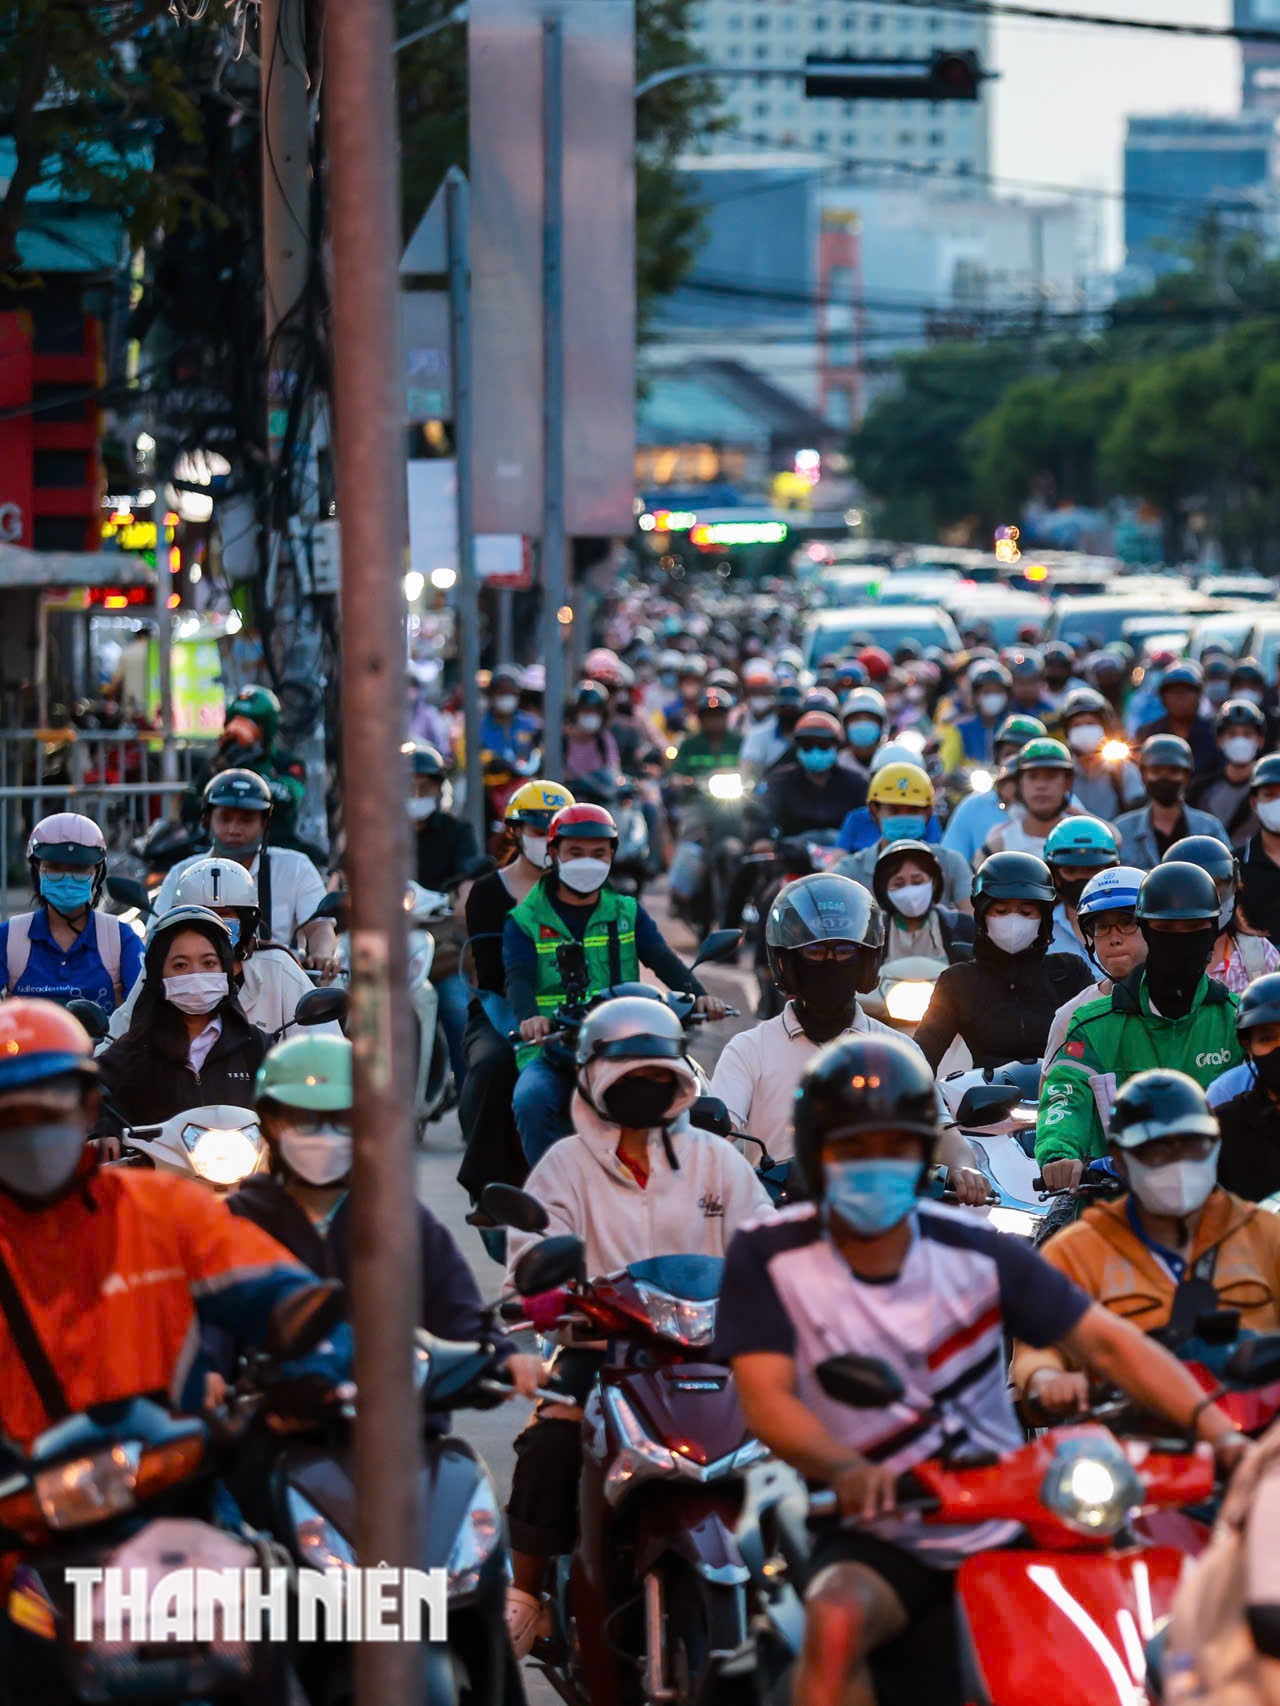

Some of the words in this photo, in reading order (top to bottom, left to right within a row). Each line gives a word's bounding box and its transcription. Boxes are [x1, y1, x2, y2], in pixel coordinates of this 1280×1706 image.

[541, 791, 566, 807] be
[1098, 879, 1120, 887] YAMAHA
[1195, 1047, 1232, 1068] Grab
